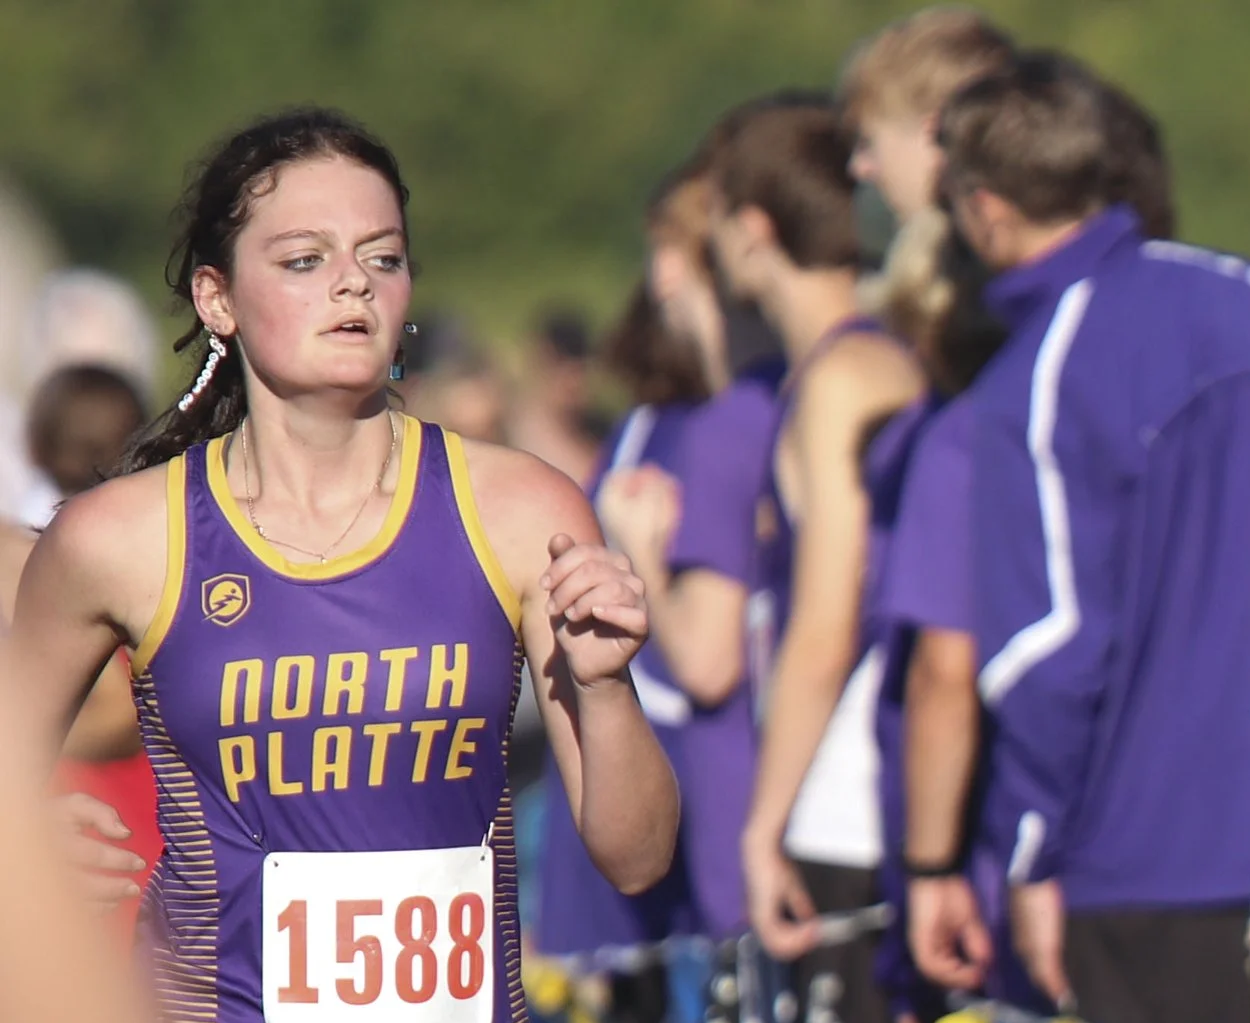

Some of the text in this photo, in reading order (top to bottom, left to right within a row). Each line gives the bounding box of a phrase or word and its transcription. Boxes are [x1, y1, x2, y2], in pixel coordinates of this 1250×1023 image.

[220, 643, 468, 727] NORTH
[218, 718, 486, 803] PLATTE
[277, 892, 485, 1005] 1588
